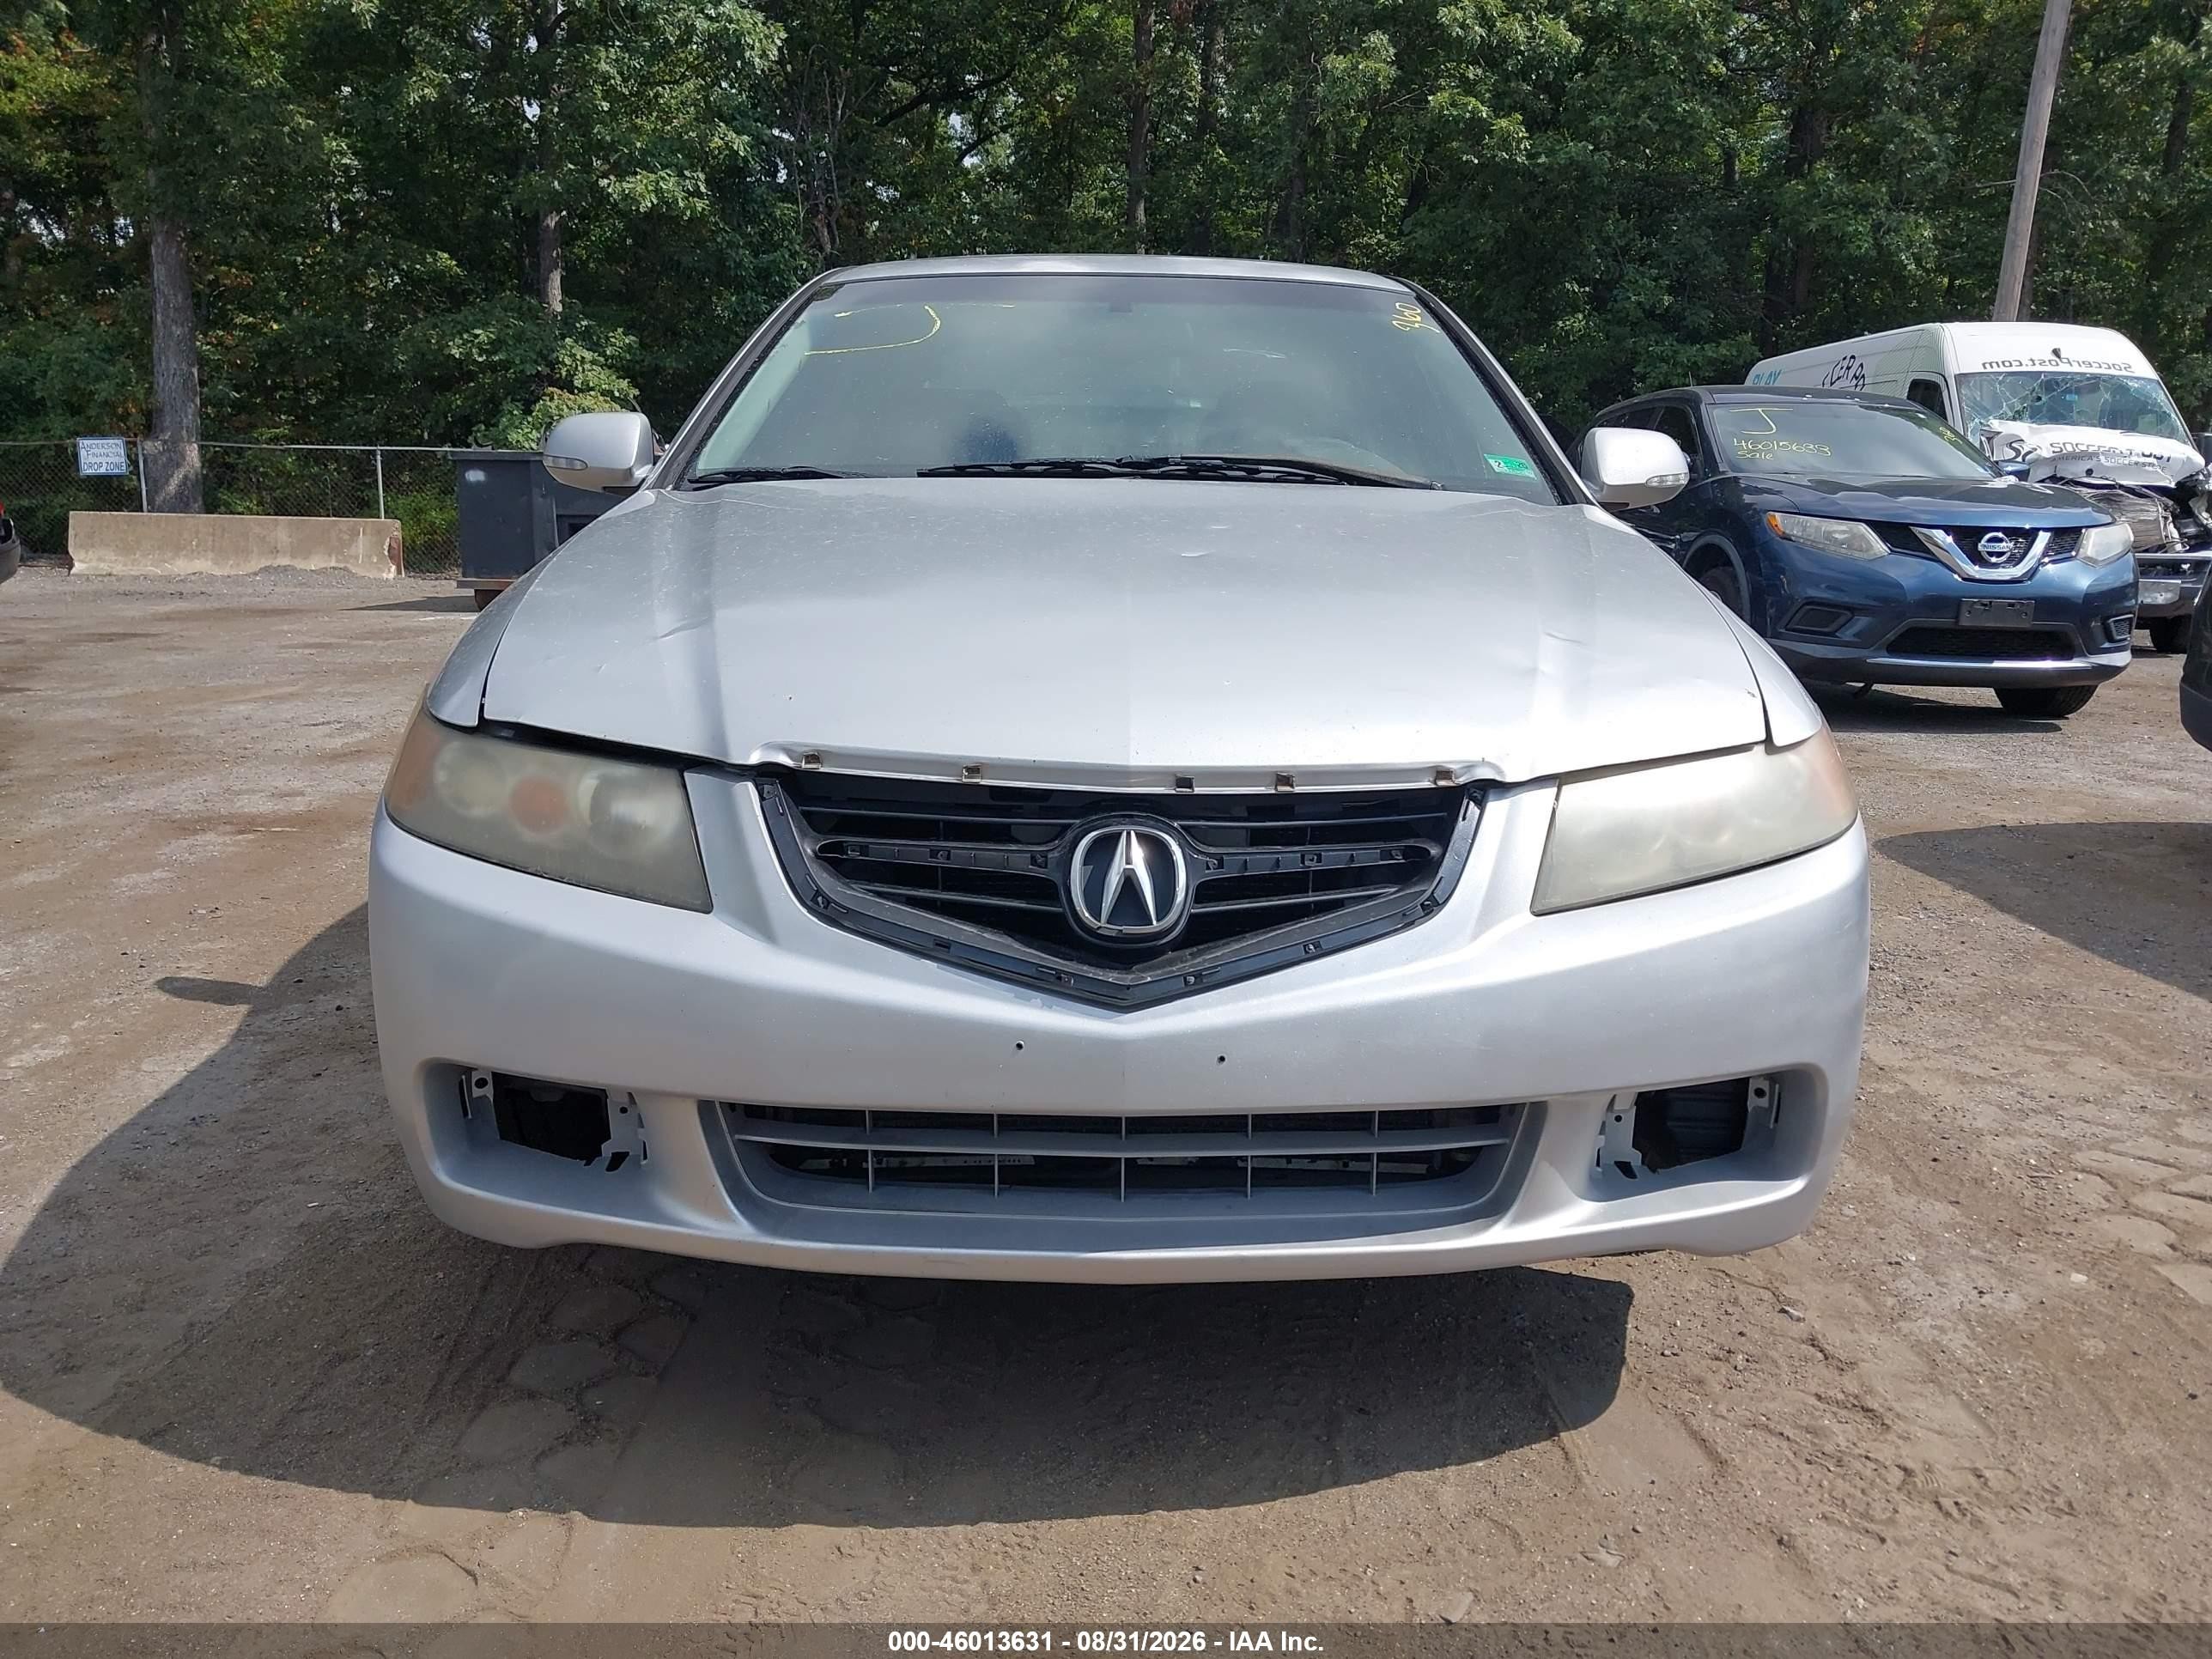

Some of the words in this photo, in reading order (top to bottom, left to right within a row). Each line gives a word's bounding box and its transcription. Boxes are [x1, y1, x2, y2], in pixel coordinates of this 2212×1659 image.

[1729, 407, 1793, 434] J
[1735, 450, 1773, 460] Sale
[83, 462, 103, 471] DROP
[105, 461, 125, 471] ZONE
